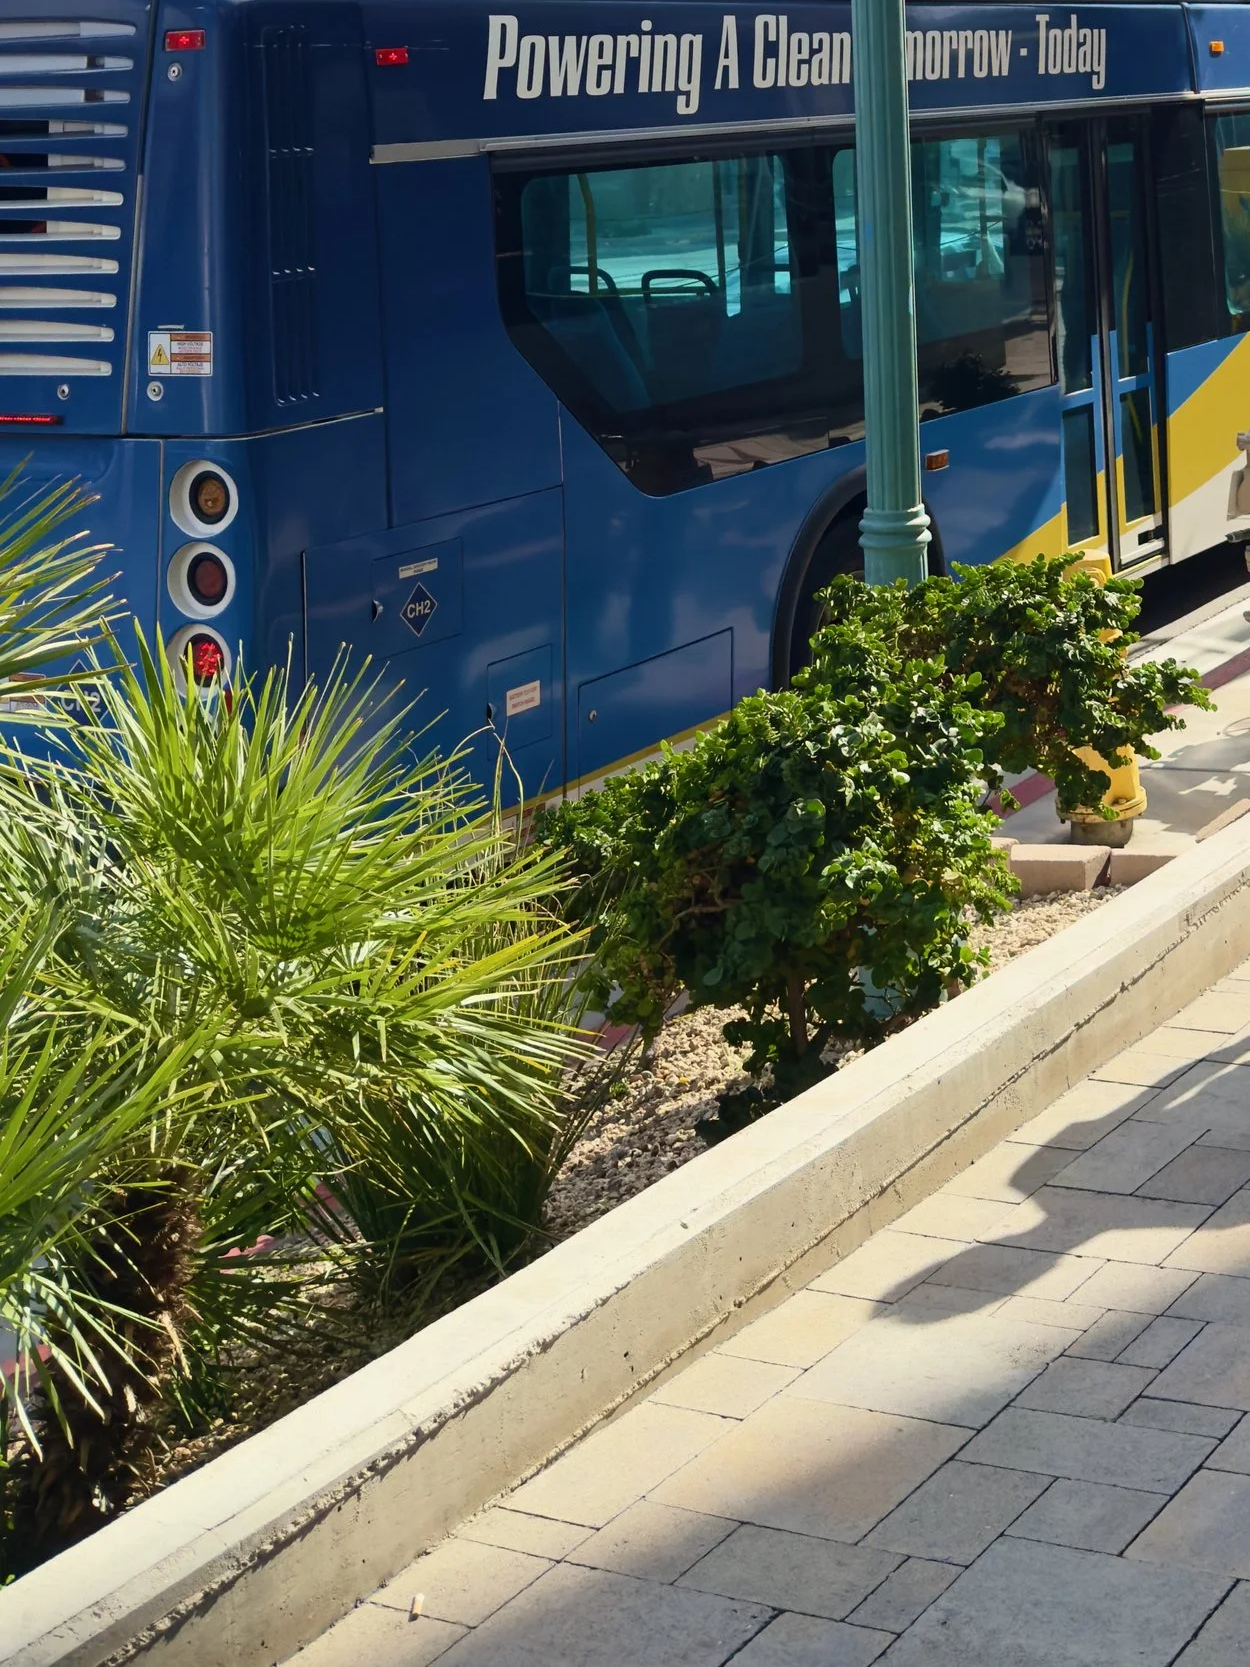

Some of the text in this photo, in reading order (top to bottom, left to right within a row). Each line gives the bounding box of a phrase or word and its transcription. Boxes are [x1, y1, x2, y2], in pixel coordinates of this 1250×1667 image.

[483, 15, 702, 115] Powering
[714, 15, 739, 90] A
[753, 14, 850, 88] Clean
[1035, 14, 1106, 90] Today
[407, 600, 431, 618] CH2
